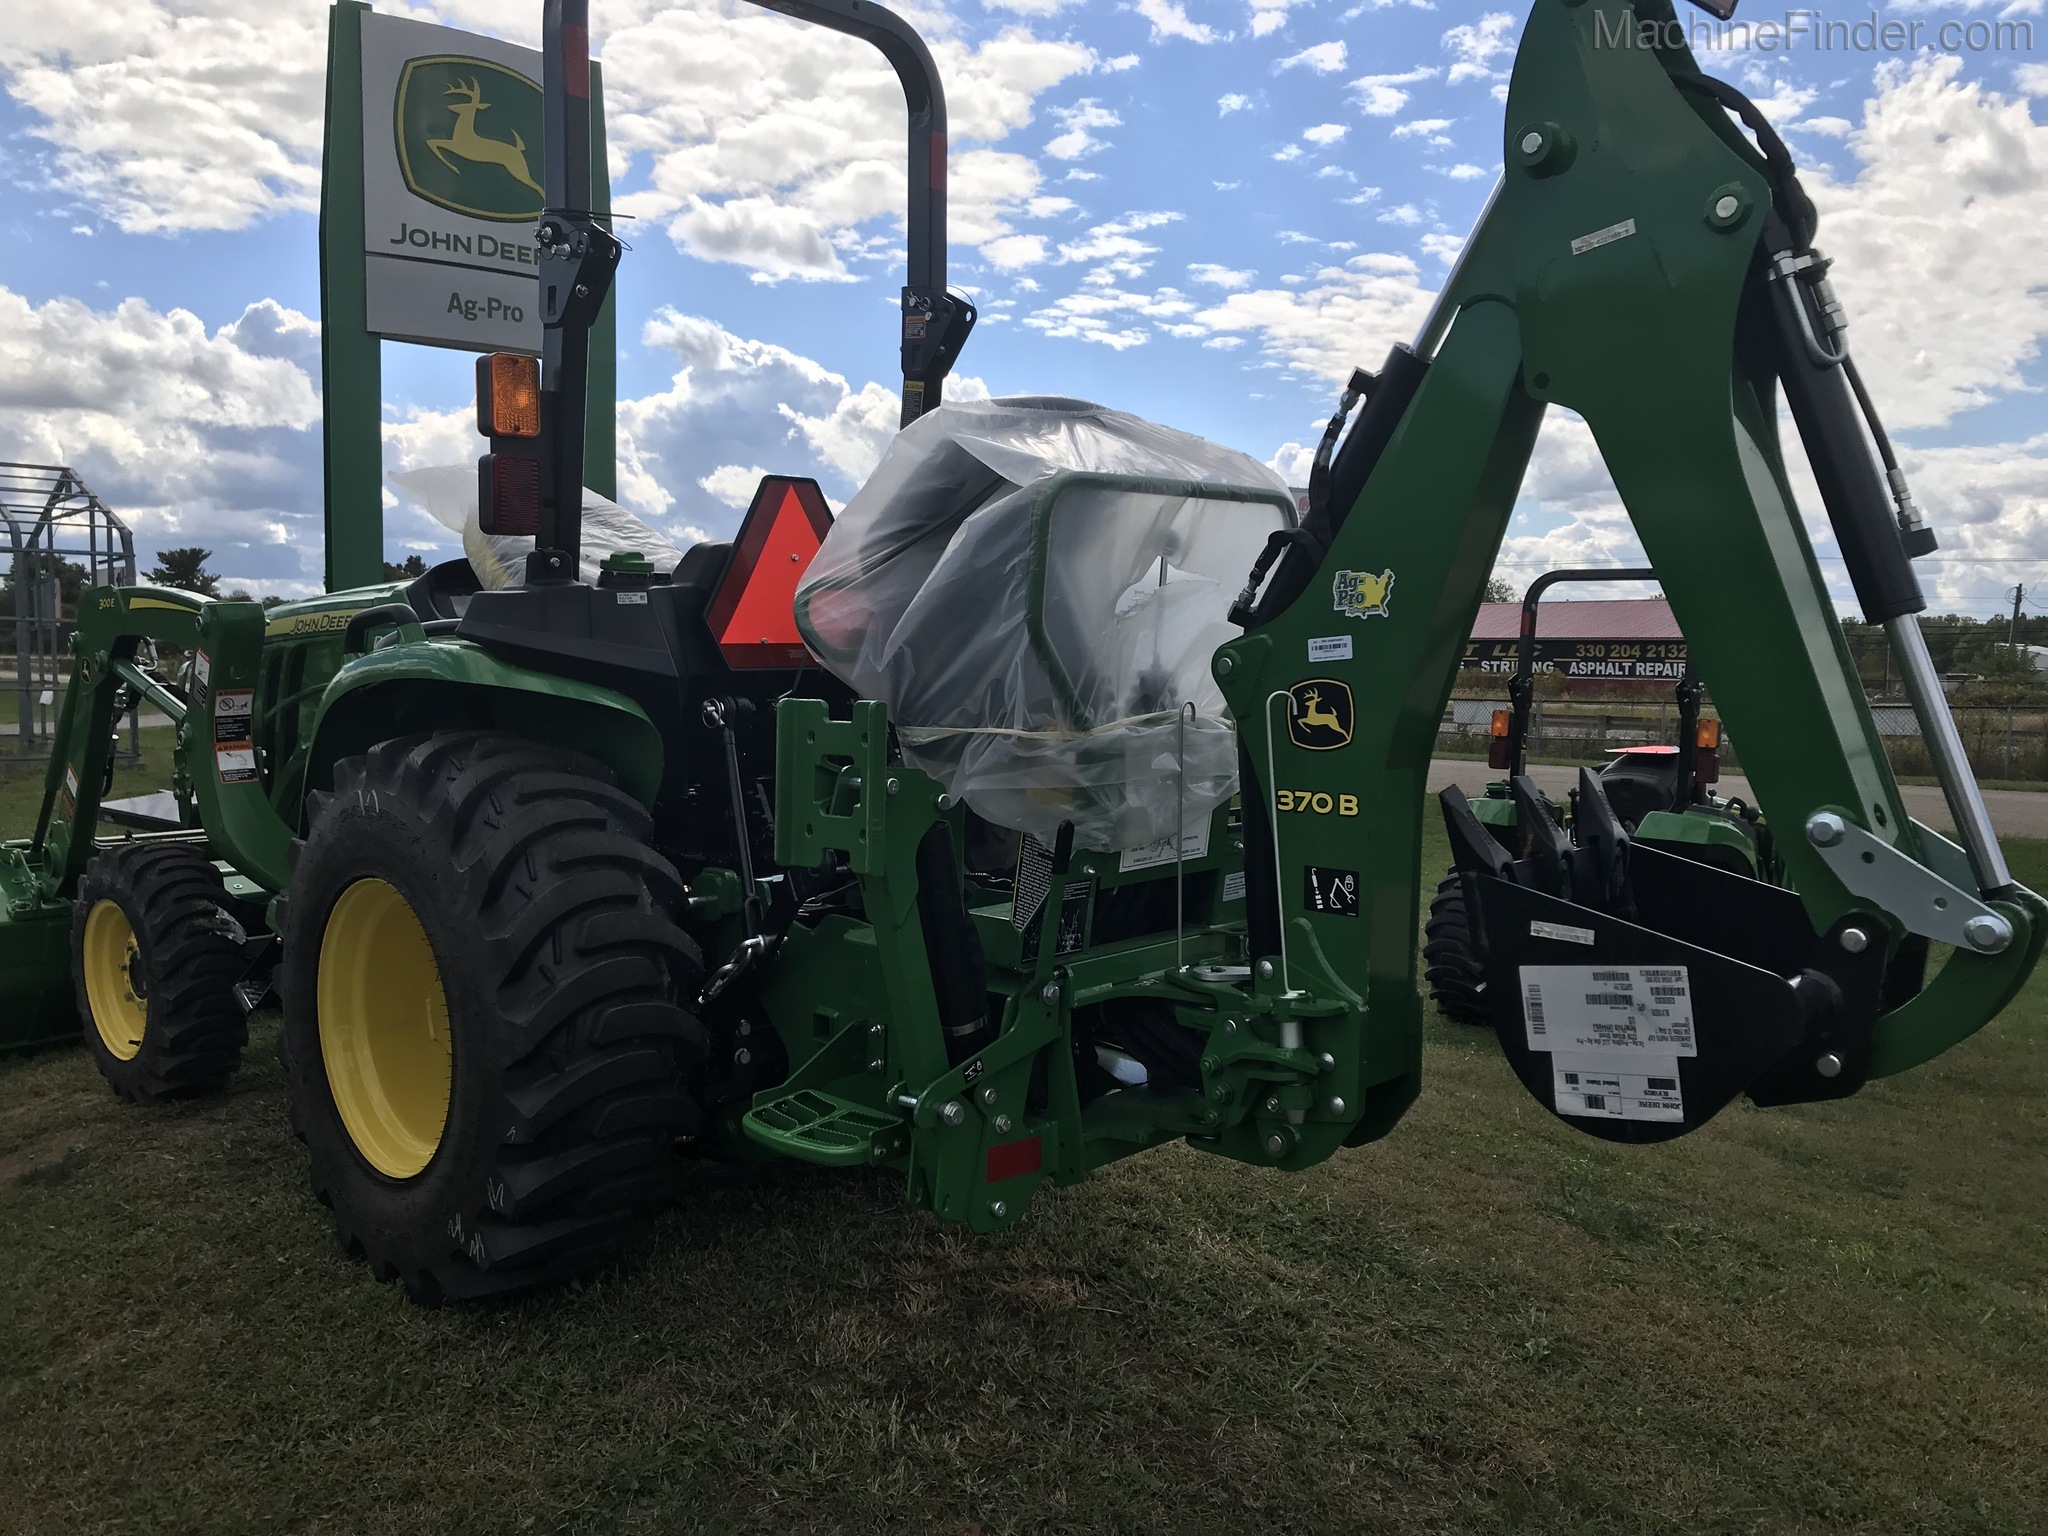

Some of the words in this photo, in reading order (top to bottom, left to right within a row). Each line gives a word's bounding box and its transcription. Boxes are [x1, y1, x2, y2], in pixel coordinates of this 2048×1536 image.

[390, 222, 472, 254] JOHN
[447, 292, 524, 323] Ag-Pro
[1336, 590, 1366, 607] Pro
[290, 616, 320, 634] JOHN
[1576, 644, 1605, 657] 330
[1610, 644, 1641, 657] 204
[1646, 644, 1688, 658] 2132
[1569, 661, 1632, 675] ASPHALT
[1276, 789, 1334, 815] 370
[1338, 793, 1360, 817] B
